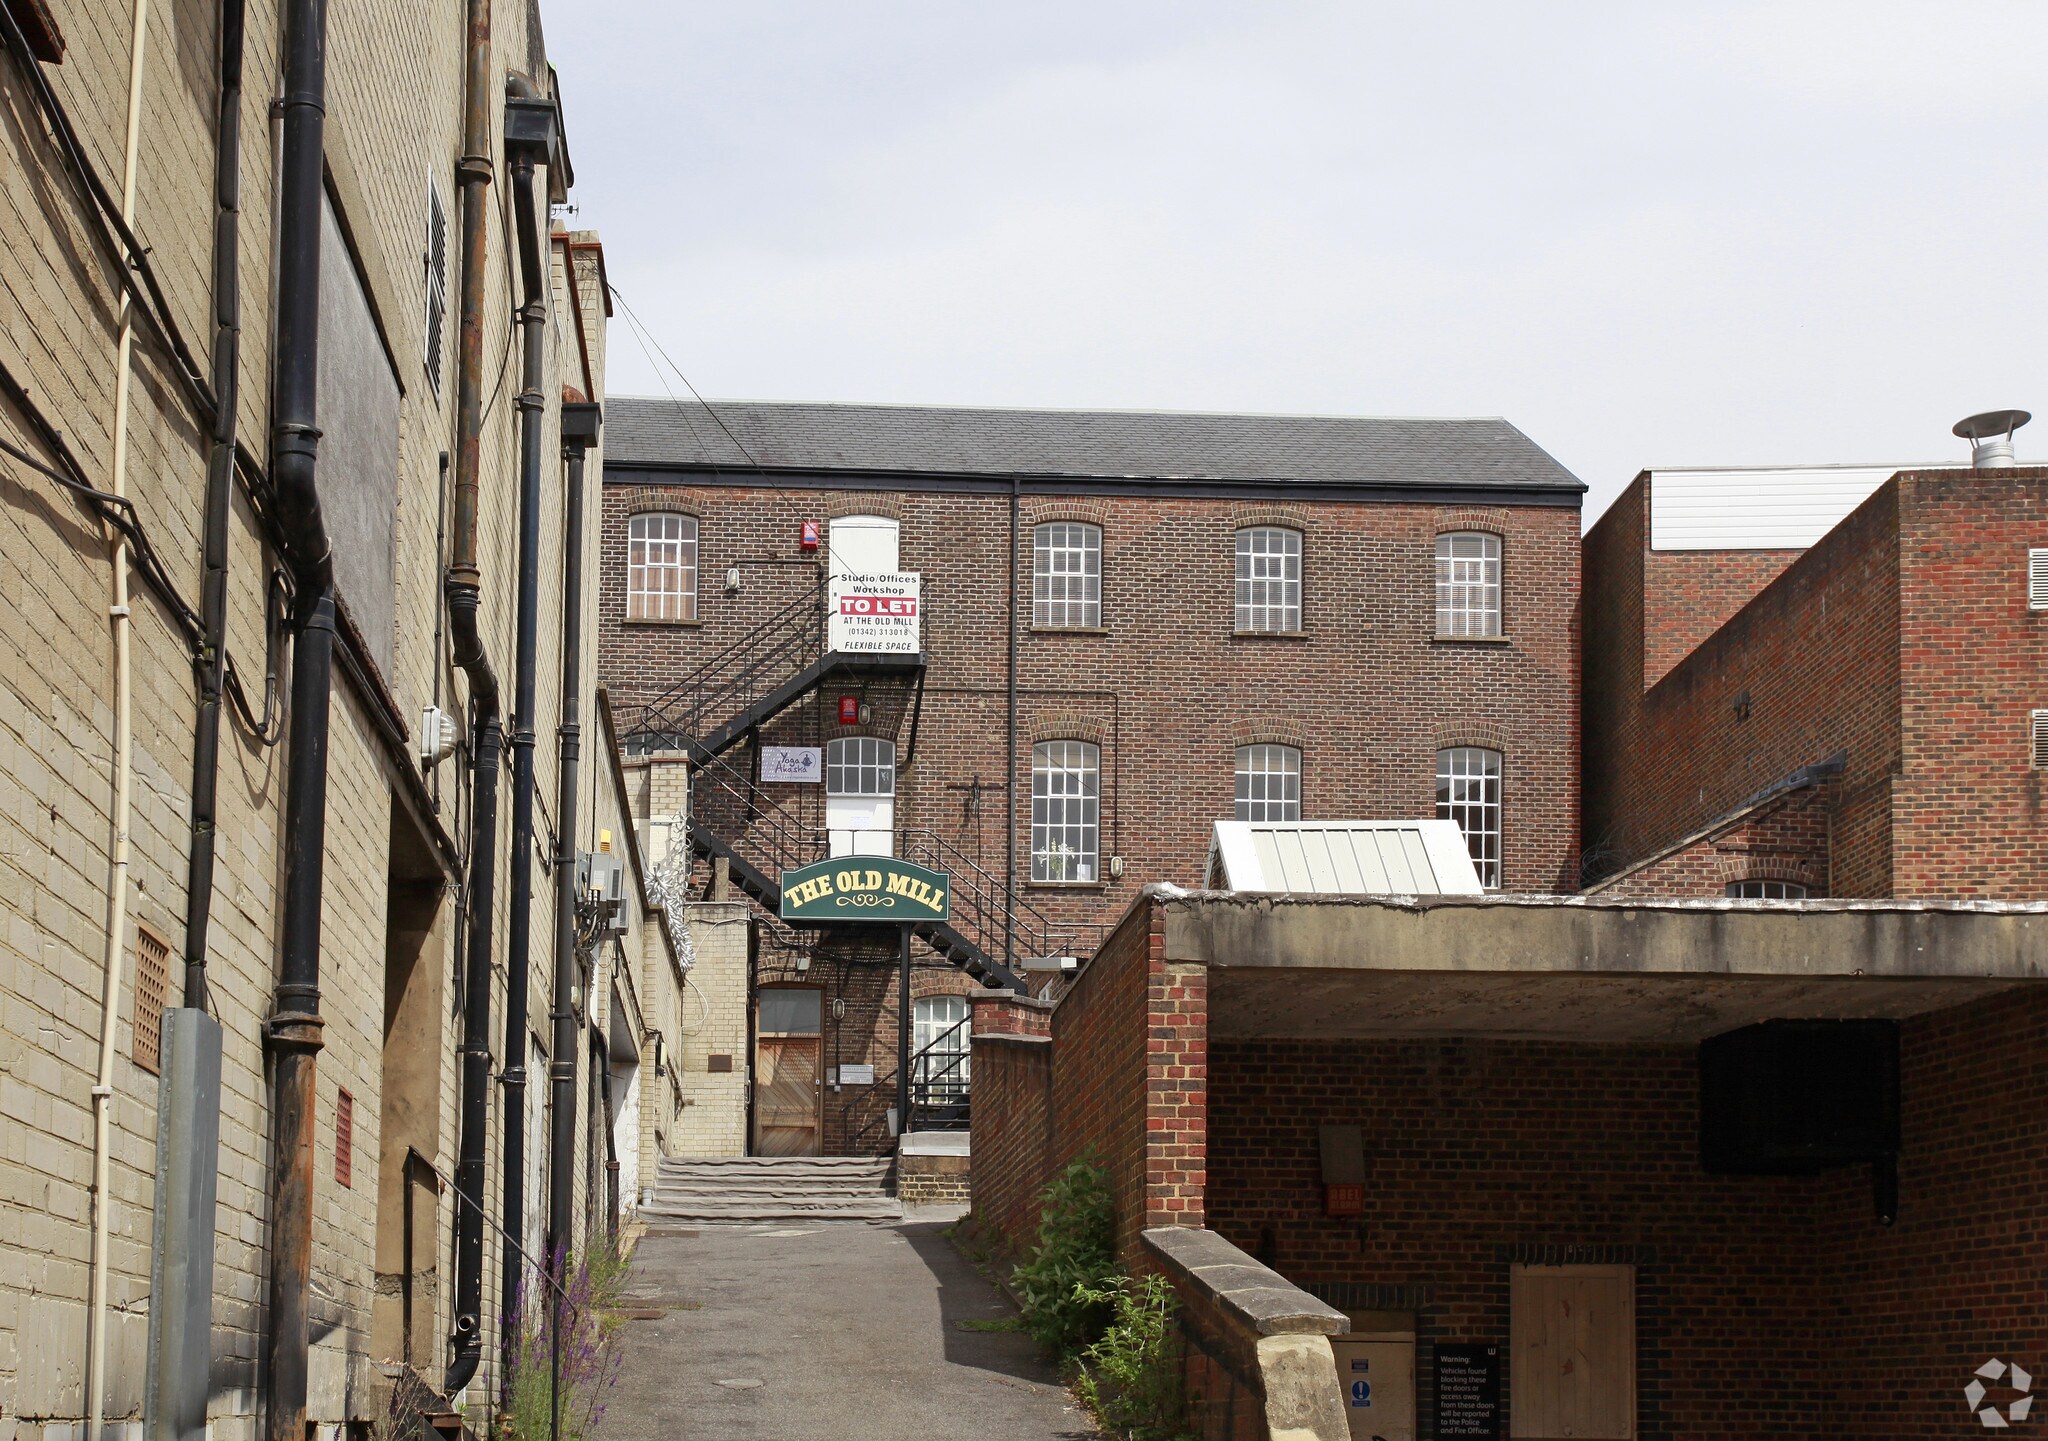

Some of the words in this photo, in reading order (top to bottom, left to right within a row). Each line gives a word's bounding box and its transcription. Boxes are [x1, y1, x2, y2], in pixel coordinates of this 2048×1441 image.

[841, 573, 917, 584] Studio/Offices
[853, 586, 905, 596] Workshop
[841, 599, 871, 613] TO
[876, 600, 916, 614] LET
[843, 617, 853, 625] AT
[856, 617, 872, 625] THE
[875, 617, 891, 626] OLD
[893, 618, 913, 626] MILL
[848, 628, 877, 637] (01342)
[879, 629, 909, 637] 313018
[844, 641, 883, 650] FLEXIBLE
[885, 642, 912, 650] SPACE
[780, 752, 800, 767] Yoga
[783, 874, 834, 909] THE
[836, 870, 883, 893] OLD
[885, 872, 945, 913] MILL
[1440, 1356, 1471, 1364] Warning:
[1440, 1376, 1467, 1384] blocking
[1462, 1410, 1490, 1418] reported
